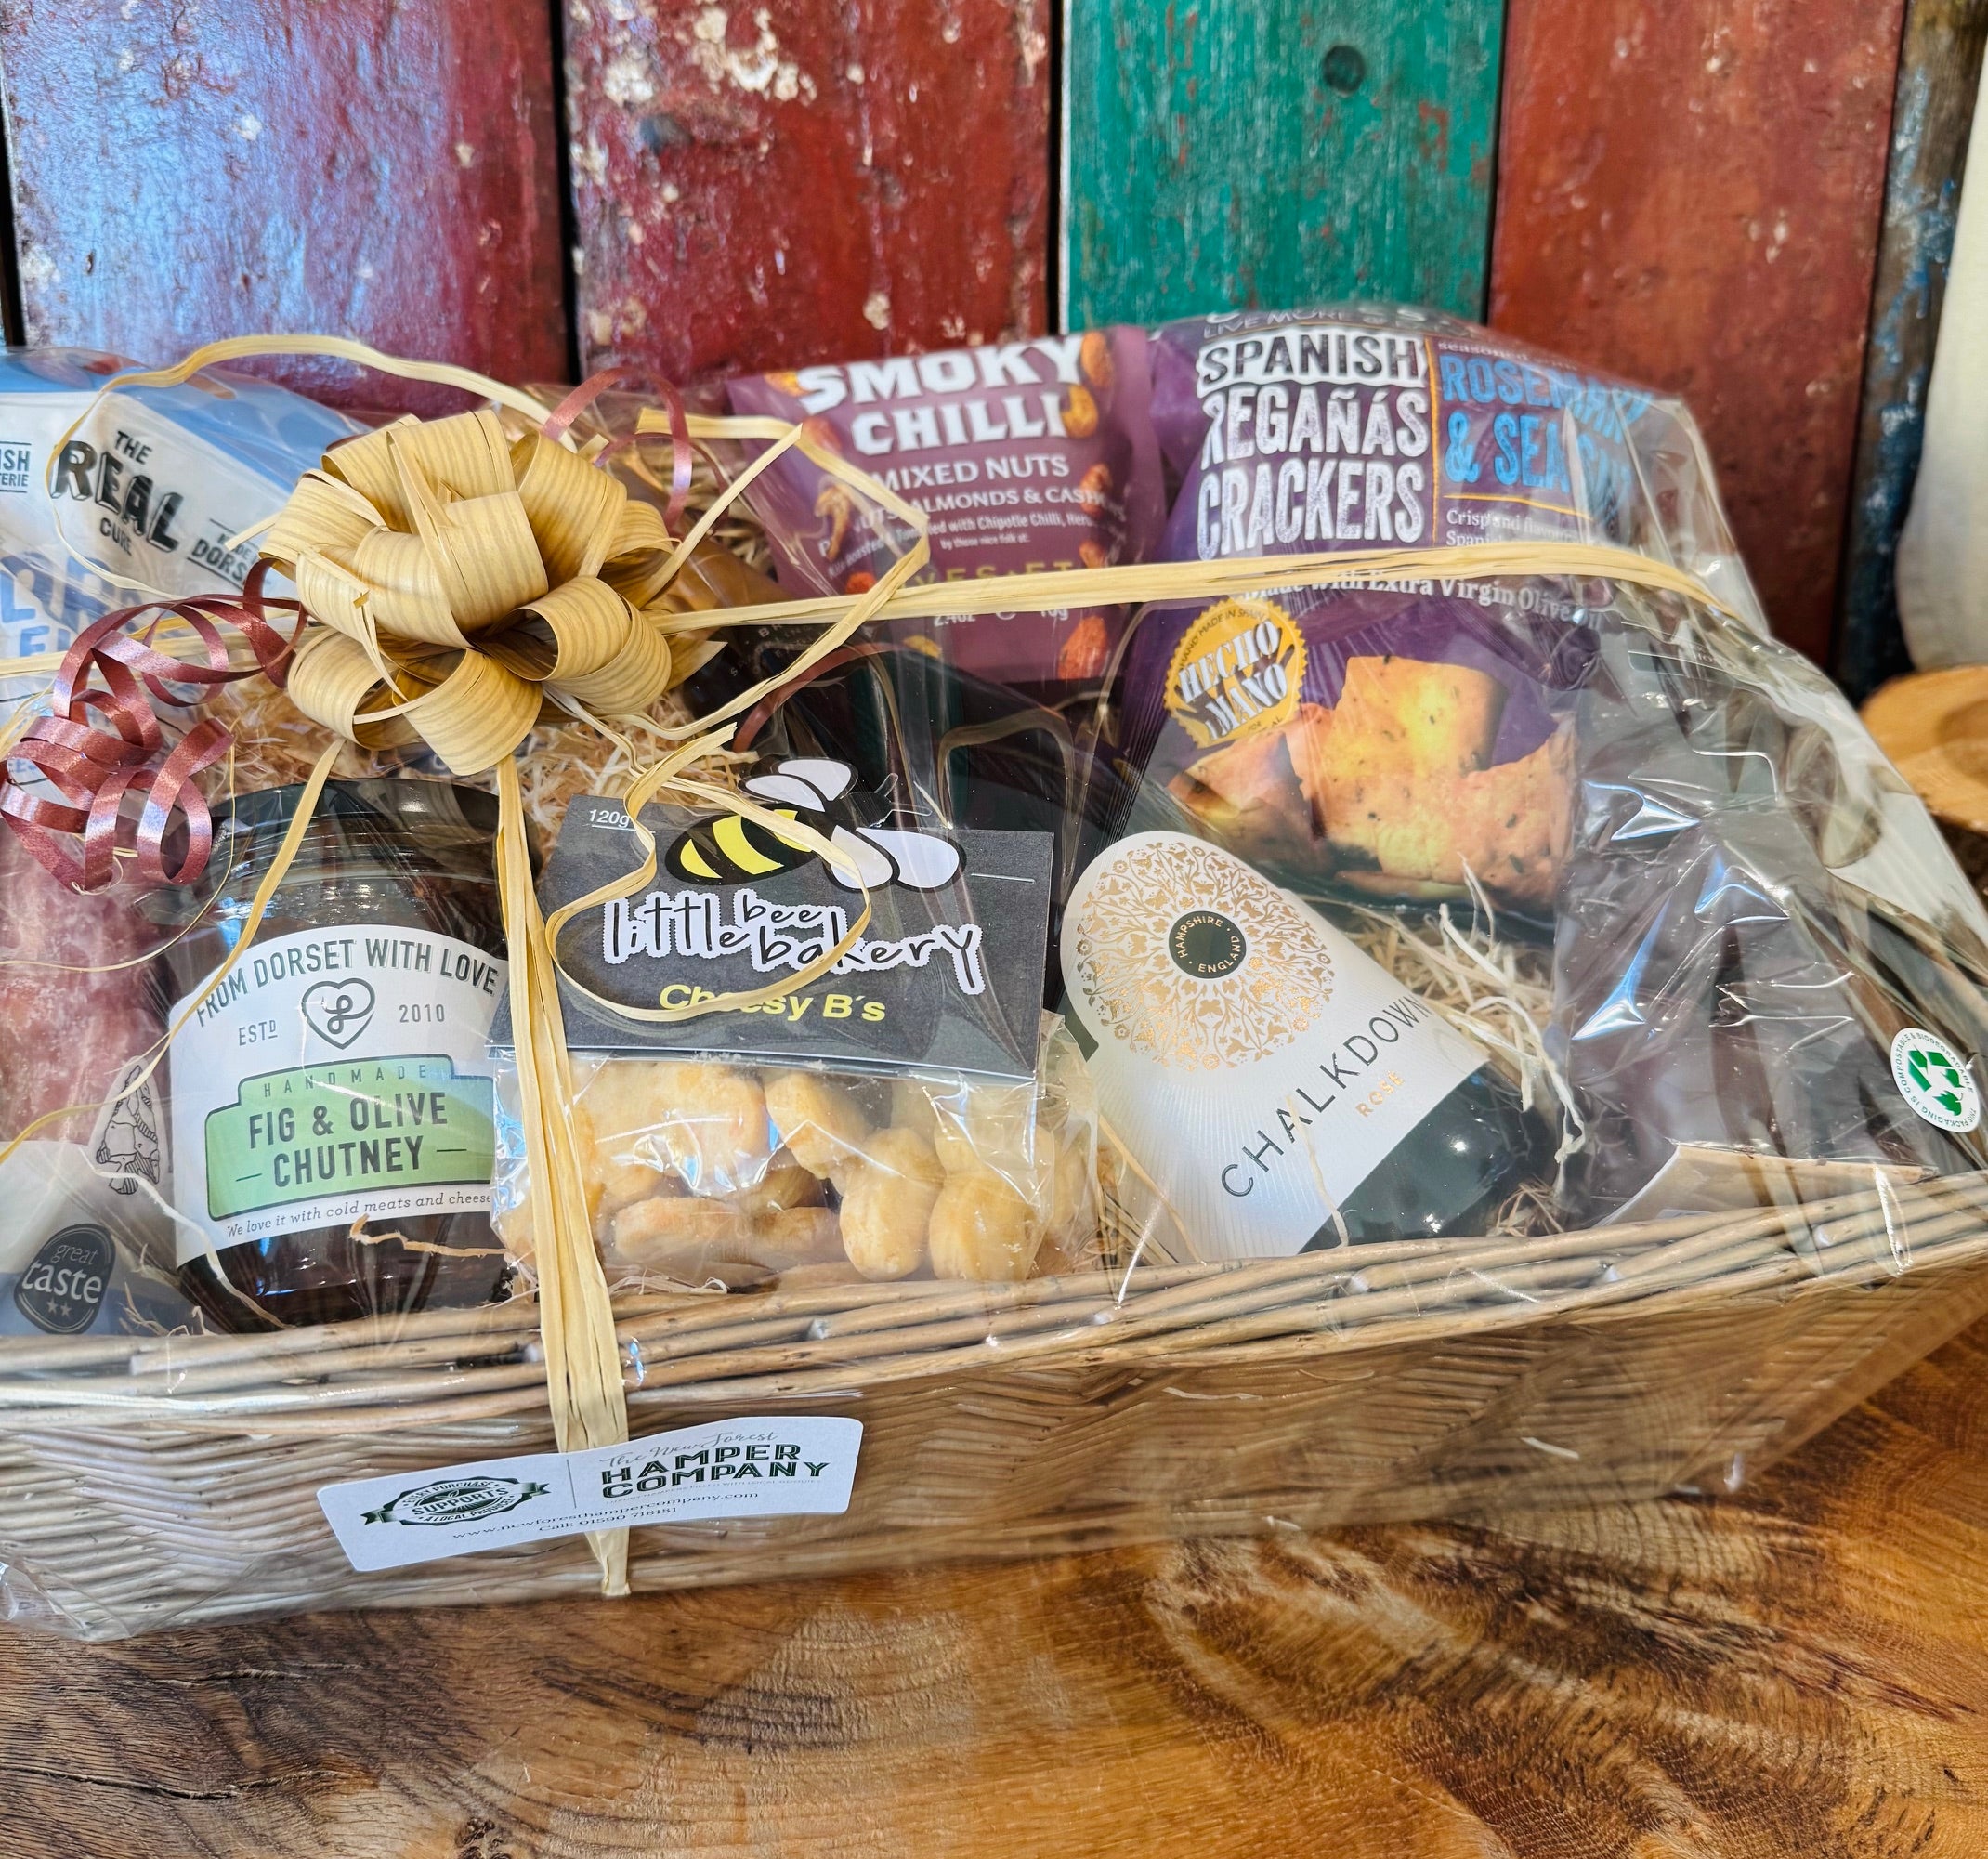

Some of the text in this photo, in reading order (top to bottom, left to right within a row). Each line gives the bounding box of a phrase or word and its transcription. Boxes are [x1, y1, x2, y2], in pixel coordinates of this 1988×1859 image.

[795, 335, 1085, 415] SMOKY
[1202, 334, 1420, 386] SPANISH
[850, 390, 1069, 456] CHILLI
[0, 449, 31, 472] SH
[114, 430, 152, 465] THE
[1444, 410, 1482, 484] &
[1493, 412, 1570, 494] SEA
[0, 473, 29, 487] ERIE
[873, 452, 1070, 492] MIXED NUTS
[50, 440, 184, 554] REAL
[1197, 457, 1426, 562] CRACKERS
[99, 517, 133, 557] CURE
[1445, 509, 1490, 530] Crisp
[1367, 569, 1432, 596] Extra
[1440, 578, 1515, 607] Virgin
[1517, 586, 1571, 622] Olive
[1198, 613, 1224, 636] MADE
[1178, 620, 1280, 705] HECHO
[1205, 662, 1288, 740] MANO
[588, 808, 630, 829] 120g
[612, 894, 976, 988] little bee bakery
[1174, 915, 1223, 959] HAMPSHIRE
[1197, 935, 1242, 974] ENGLAND
[196, 937, 500, 1028] FROM DORSET WITH LOVE
[659, 983, 814, 1022] Chsy
[399, 1003, 446, 1024] 2010
[263, 1064, 427, 1098] HANDMADE
[1895, 1033, 1912, 1093] COMPOSTABLE
[1221, 994, 1432, 1198] CHALKDOWN
[248, 1091, 449, 1150] FIG & OLIVE
[273, 1134, 425, 1188] CHUTNEY
[226, 1224, 242, 1238] We
[245, 1217, 271, 1233] love
[276, 1213, 286, 1227] it
[290, 1206, 321, 1223] with
[325, 1199, 360, 1217] cold
[364, 1197, 412, 1212] meats
[415, 1191, 445, 1207] and
[50, 1244, 99, 1265] great
[21, 1259, 102, 1304] taste
[599, 1452, 647, 1468] The
[701, 1431, 778, 1450] Forest
[600, 1442, 802, 1485] HAMPER
[412, 1487, 510, 1515] SUPPORTS
[432, 1481, 494, 1492] PURCHASE
[602, 1461, 831, 1499] COMPANY
[432, 1512, 466, 1523] LOCAL
[452, 1492, 759, 1538] www.newforesthampercompany.com
[538, 1523, 573, 1532] Call:
[579, 1514, 627, 1525] 01590
